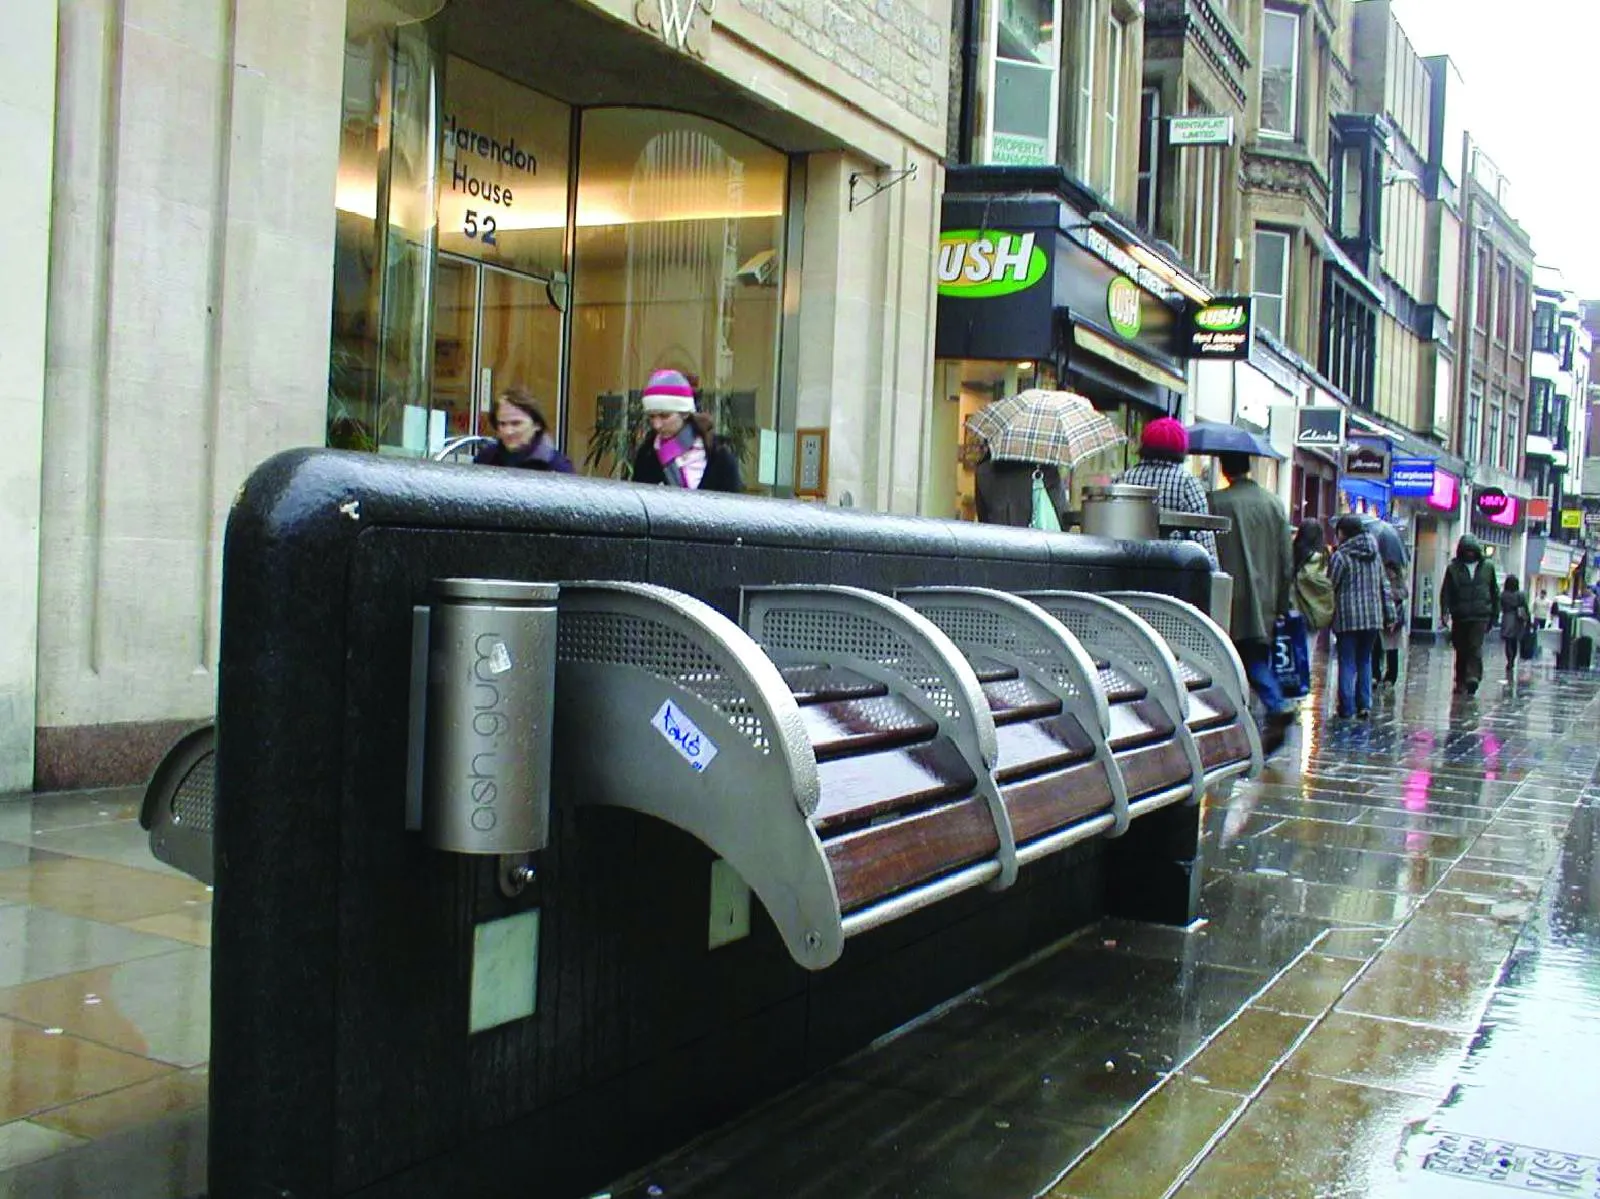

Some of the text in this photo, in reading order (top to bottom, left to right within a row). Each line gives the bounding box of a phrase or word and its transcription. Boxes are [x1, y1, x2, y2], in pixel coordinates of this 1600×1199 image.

[444, 113, 538, 176] larendon
[993, 137, 1046, 153] PROPERTY
[452, 160, 514, 207] House
[463, 208, 497, 246] 52
[938, 231, 1036, 281] USH
